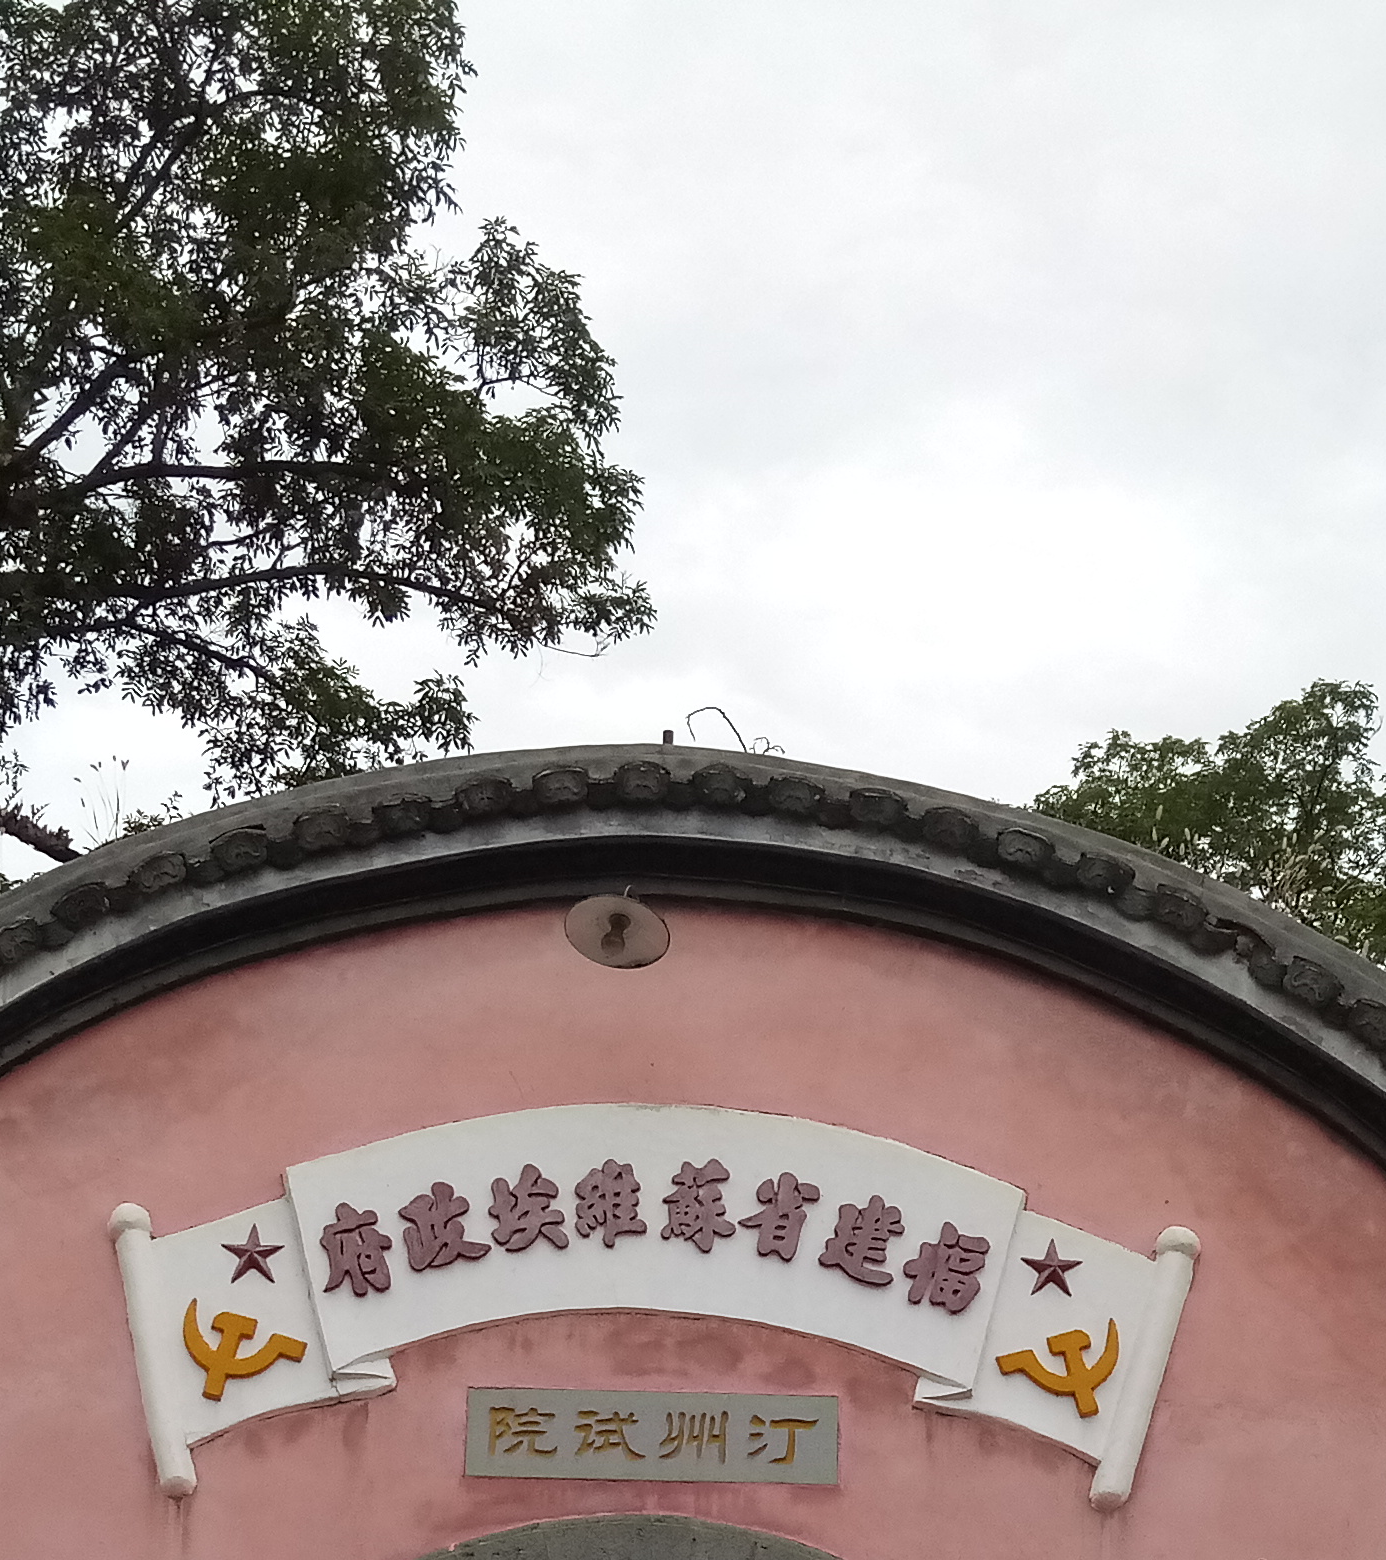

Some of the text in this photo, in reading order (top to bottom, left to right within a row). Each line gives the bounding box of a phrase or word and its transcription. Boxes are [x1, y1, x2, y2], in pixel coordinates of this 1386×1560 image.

[319, 1158, 991, 1315] 福建省蘇維埃政府
